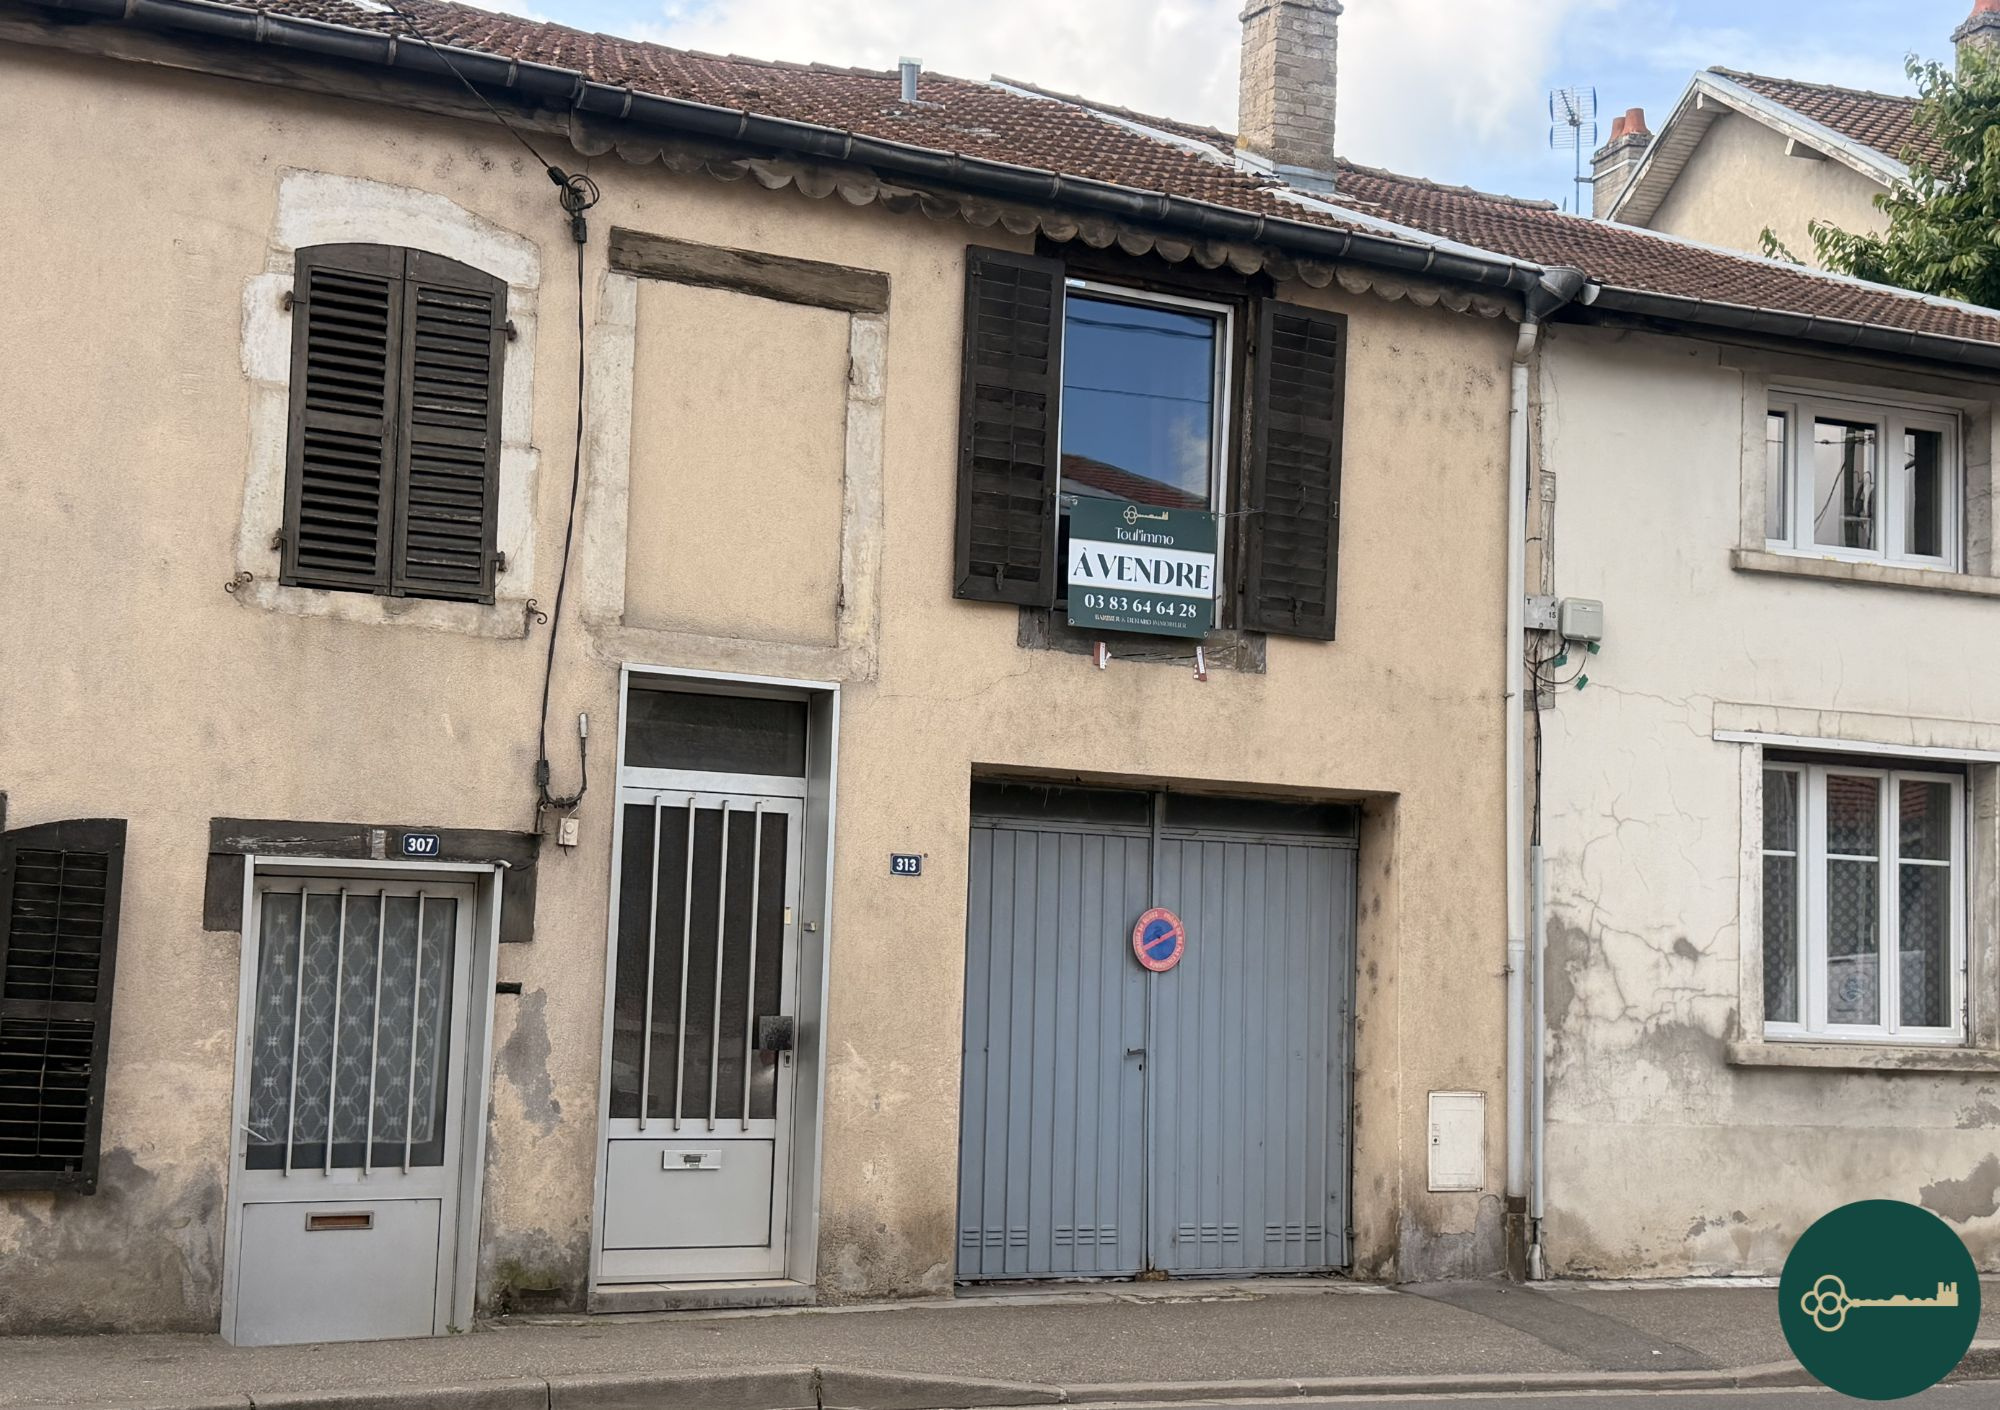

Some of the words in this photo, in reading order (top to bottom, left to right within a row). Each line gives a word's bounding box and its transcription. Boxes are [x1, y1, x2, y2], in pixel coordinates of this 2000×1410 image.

[1115, 527, 1174, 545] Toul'immo
[1073, 547, 1094, 578] À
[1097, 553, 1210, 590] VENDRE
[1084, 594, 1104, 609] 03
[1109, 596, 1128, 611] 83
[1132, 599, 1151, 613] 64
[1156, 601, 1174, 616] 64
[1179, 603, 1197, 618] 28
[407, 838, 434, 852] 307
[896, 858, 917, 871] 313
